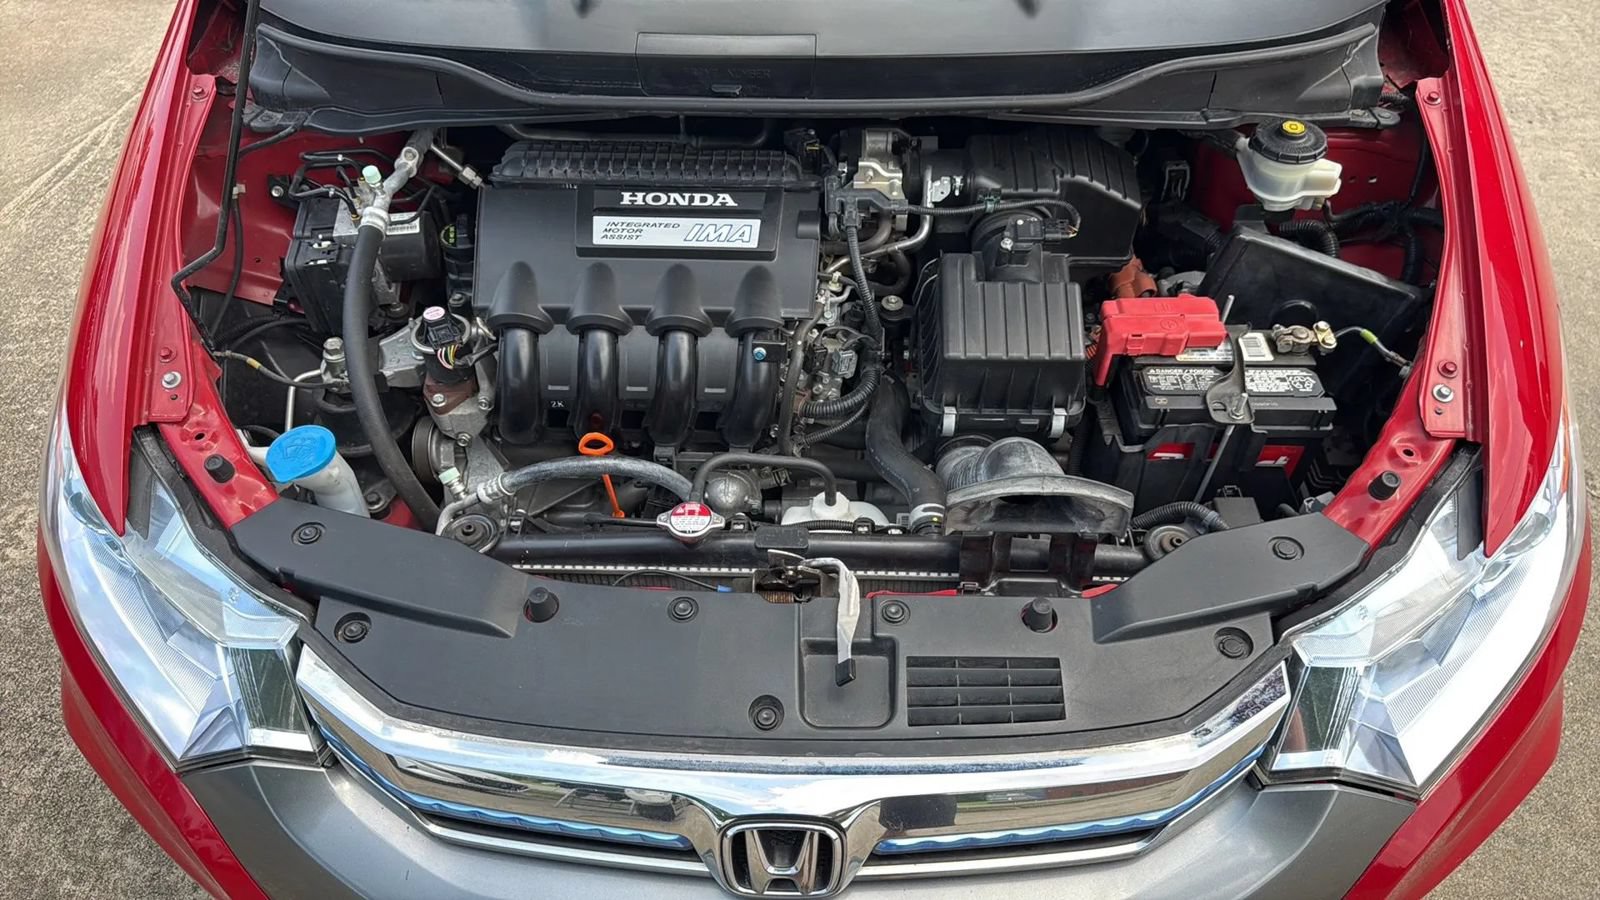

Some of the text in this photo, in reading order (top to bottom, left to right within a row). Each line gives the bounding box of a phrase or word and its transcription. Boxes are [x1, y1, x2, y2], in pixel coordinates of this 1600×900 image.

[619, 191, 738, 207] HONDA
[606, 221, 680, 229] INTEGRATED
[683, 223, 752, 243] IMA
